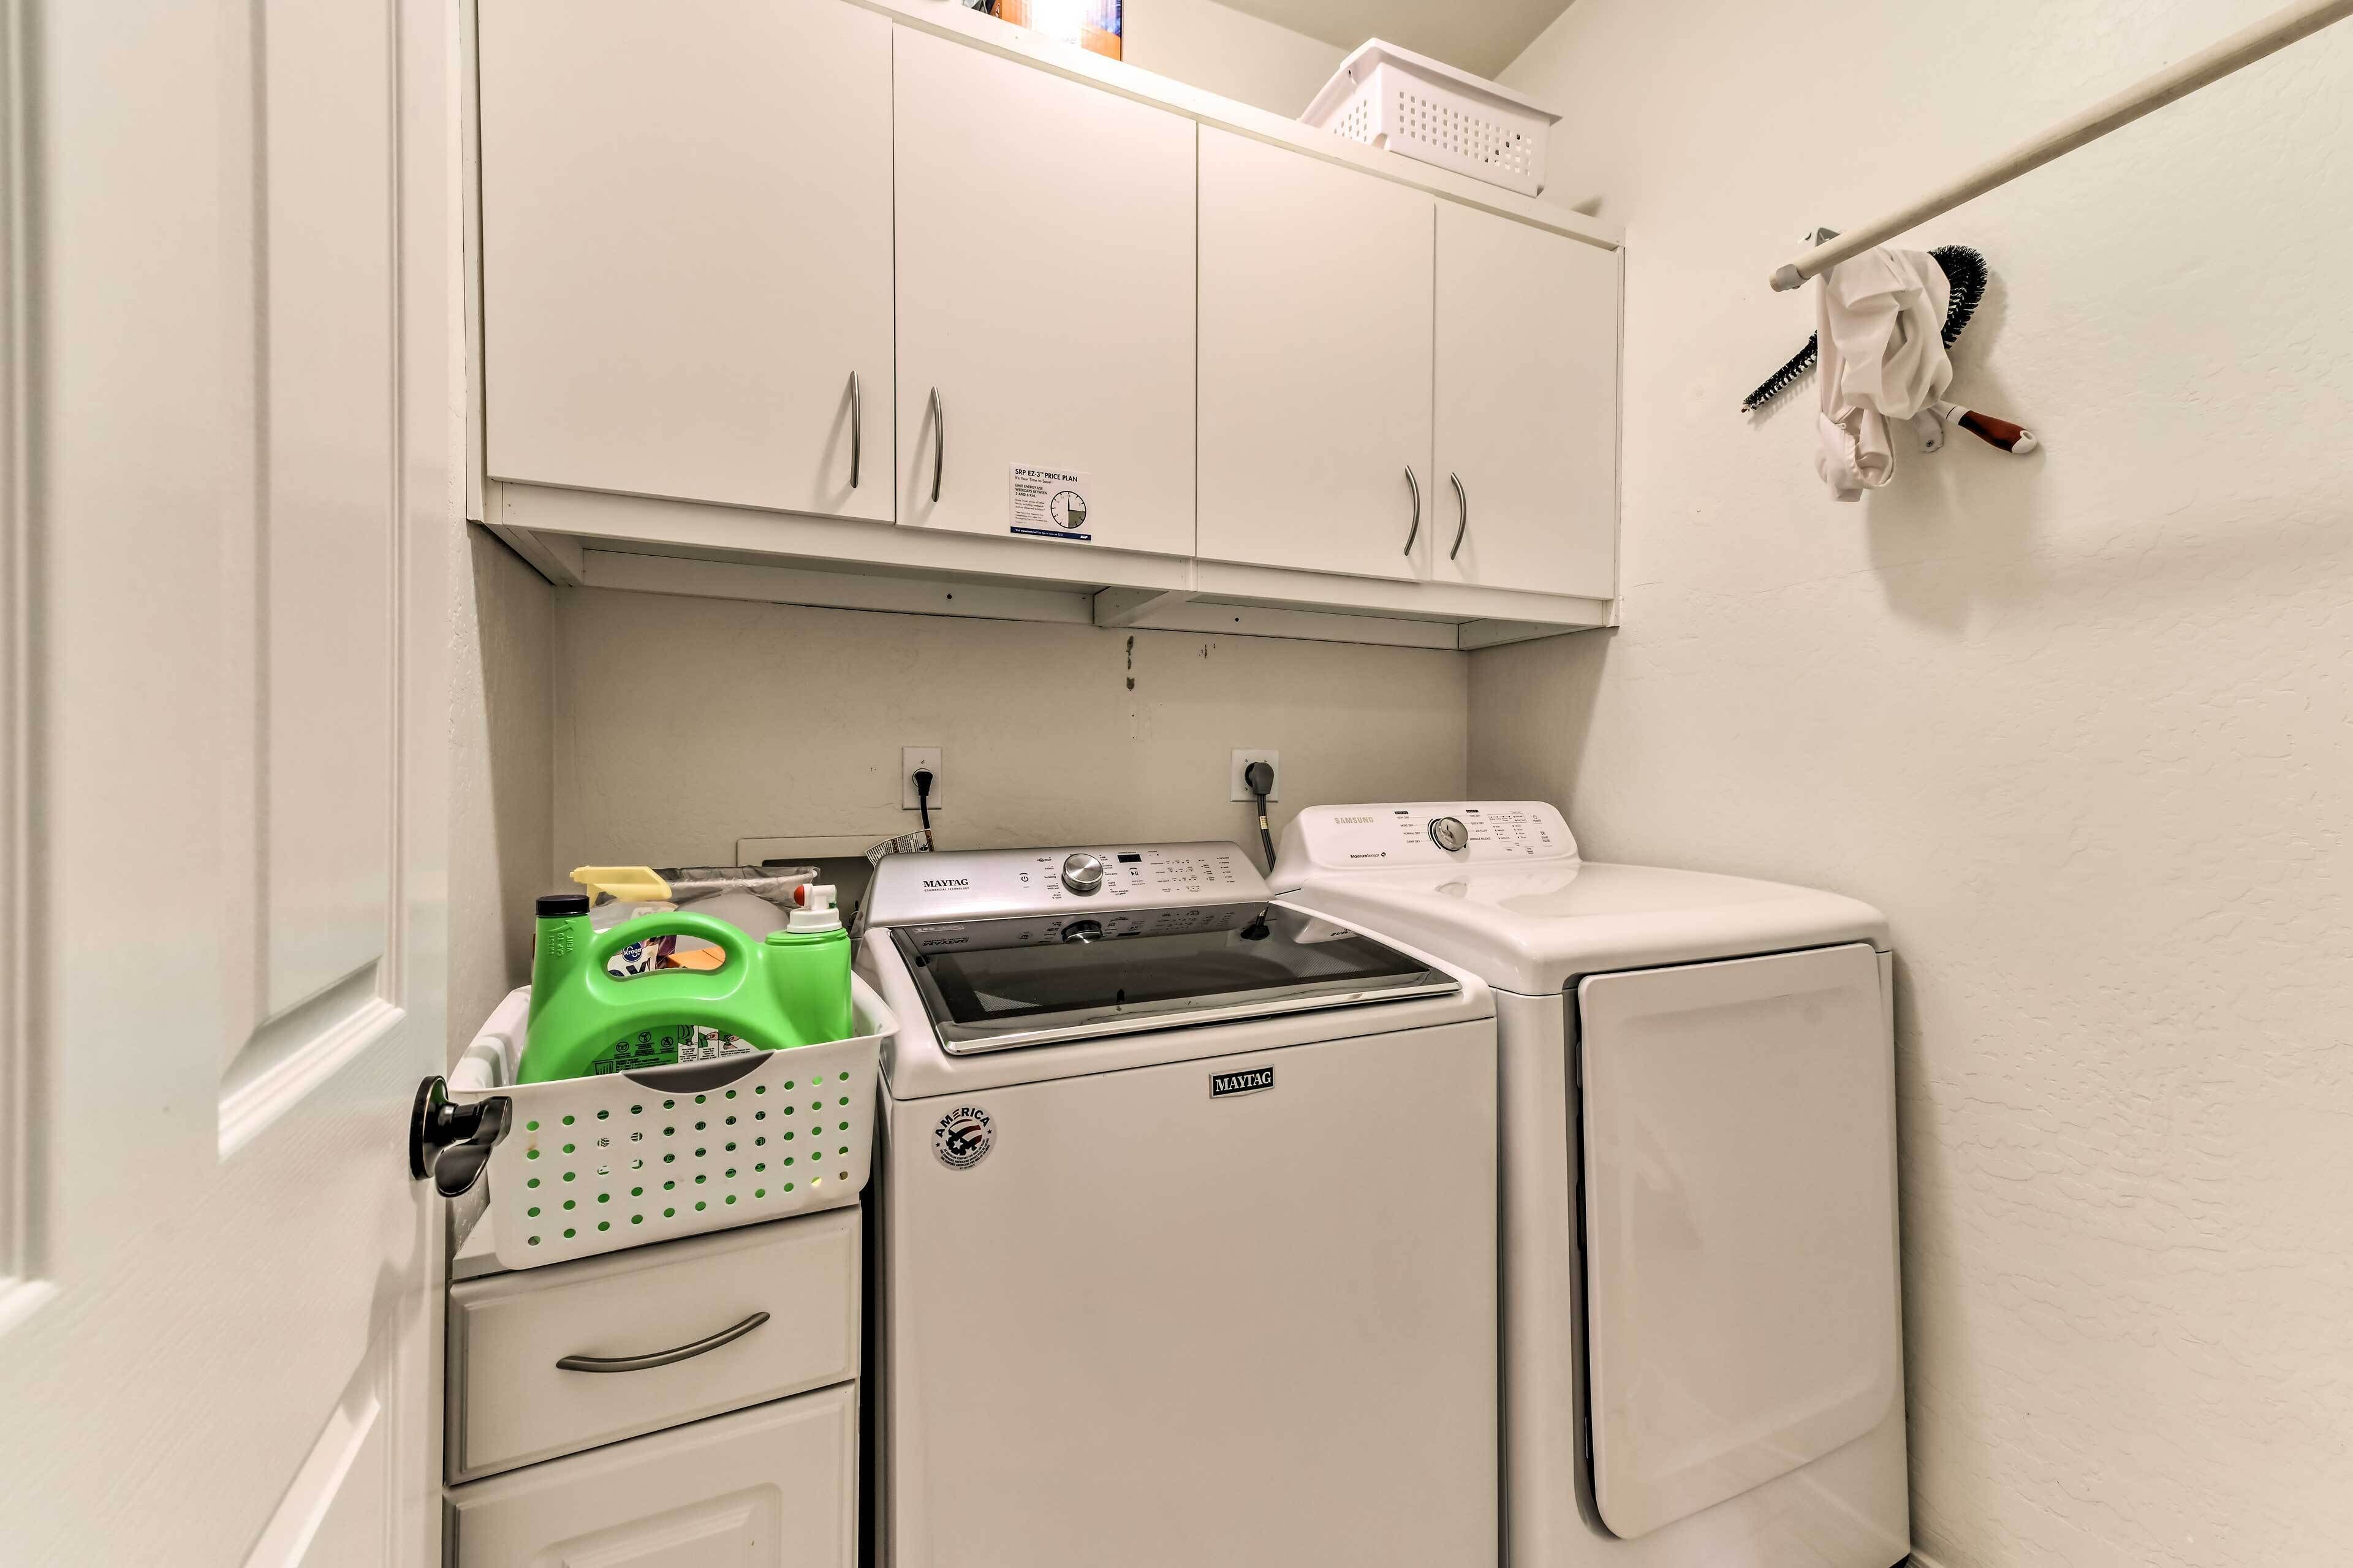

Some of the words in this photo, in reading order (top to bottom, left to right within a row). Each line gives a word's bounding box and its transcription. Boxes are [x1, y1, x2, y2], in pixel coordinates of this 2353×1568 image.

[923, 879, 969, 888] MAYTAG
[624, 945, 642, 958] Kroger
[1215, 1071, 1271, 1092] MAYTAG
[935, 1107, 990, 1138] AMERICA
[946, 1151, 957, 1159] AMERICAN
